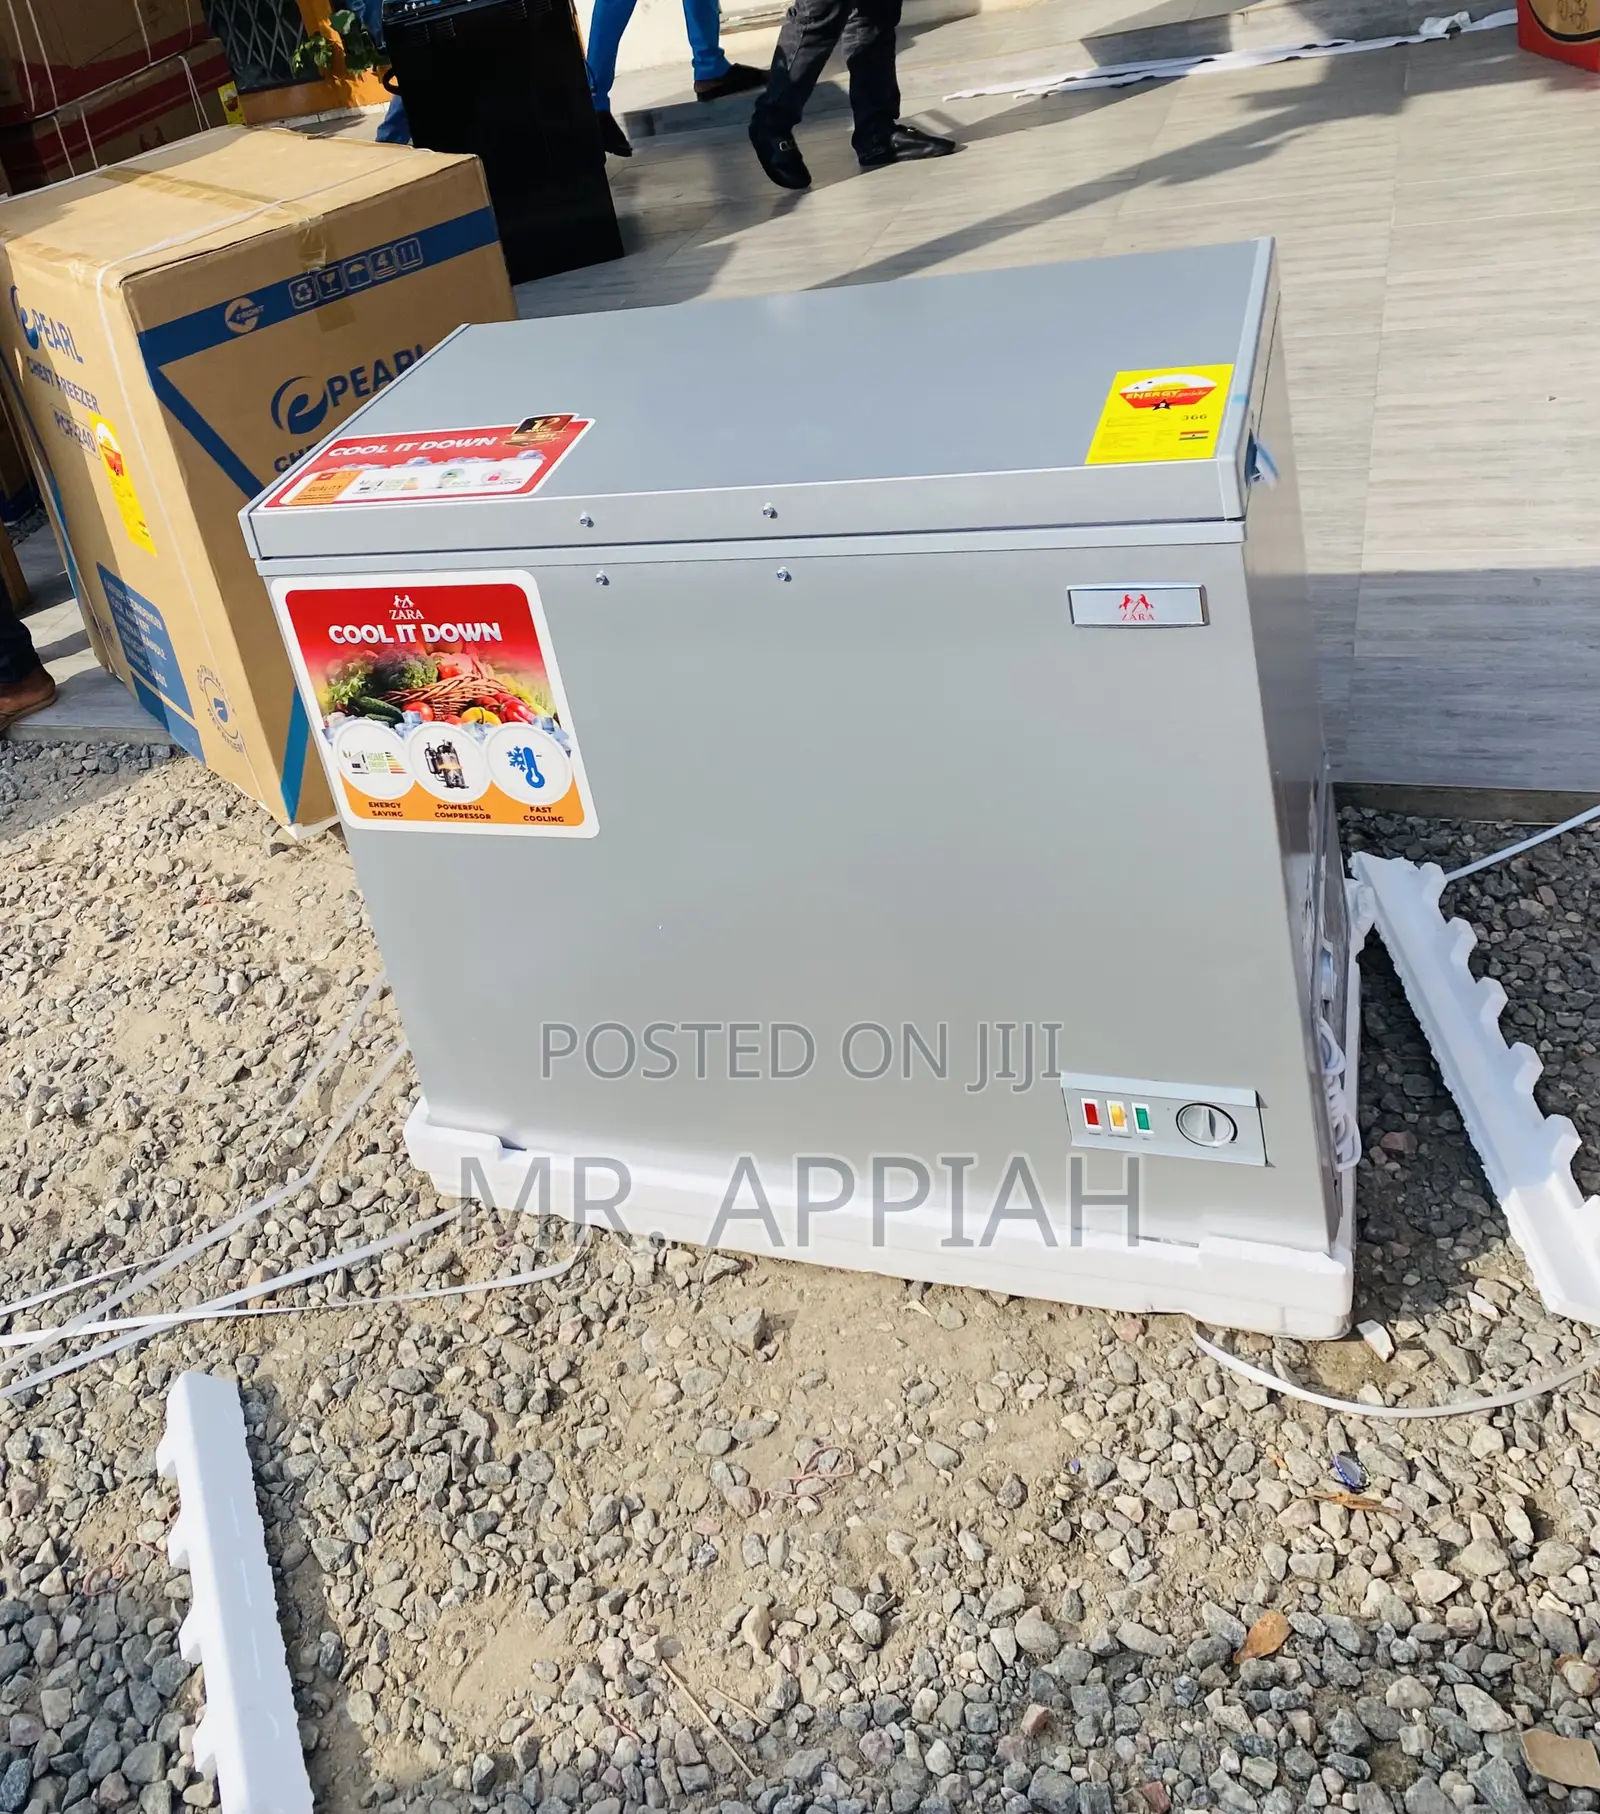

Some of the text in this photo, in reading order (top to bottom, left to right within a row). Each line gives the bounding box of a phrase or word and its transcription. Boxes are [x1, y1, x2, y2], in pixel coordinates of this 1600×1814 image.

[31, 308, 84, 364] PEARL
[54, 372, 101, 416] FREEZER
[1125, 389, 1180, 399] ENERGY
[328, 444, 389, 458] COOL
[393, 441, 420, 453] IT
[421, 436, 499, 451] DOWN
[389, 608, 425, 620] ZARA
[1121, 613, 1155, 621] ZARA
[328, 621, 503, 645] COOL IT DOWN
[368, 802, 402, 810] ENERGY
[436, 803, 485, 812] POWERFUL
[529, 806, 552, 814] FAST
[371, 810, 403, 818] SAVING
[434, 812, 492, 821] COMPRESSOR
[523, 815, 565, 823] COOLING
